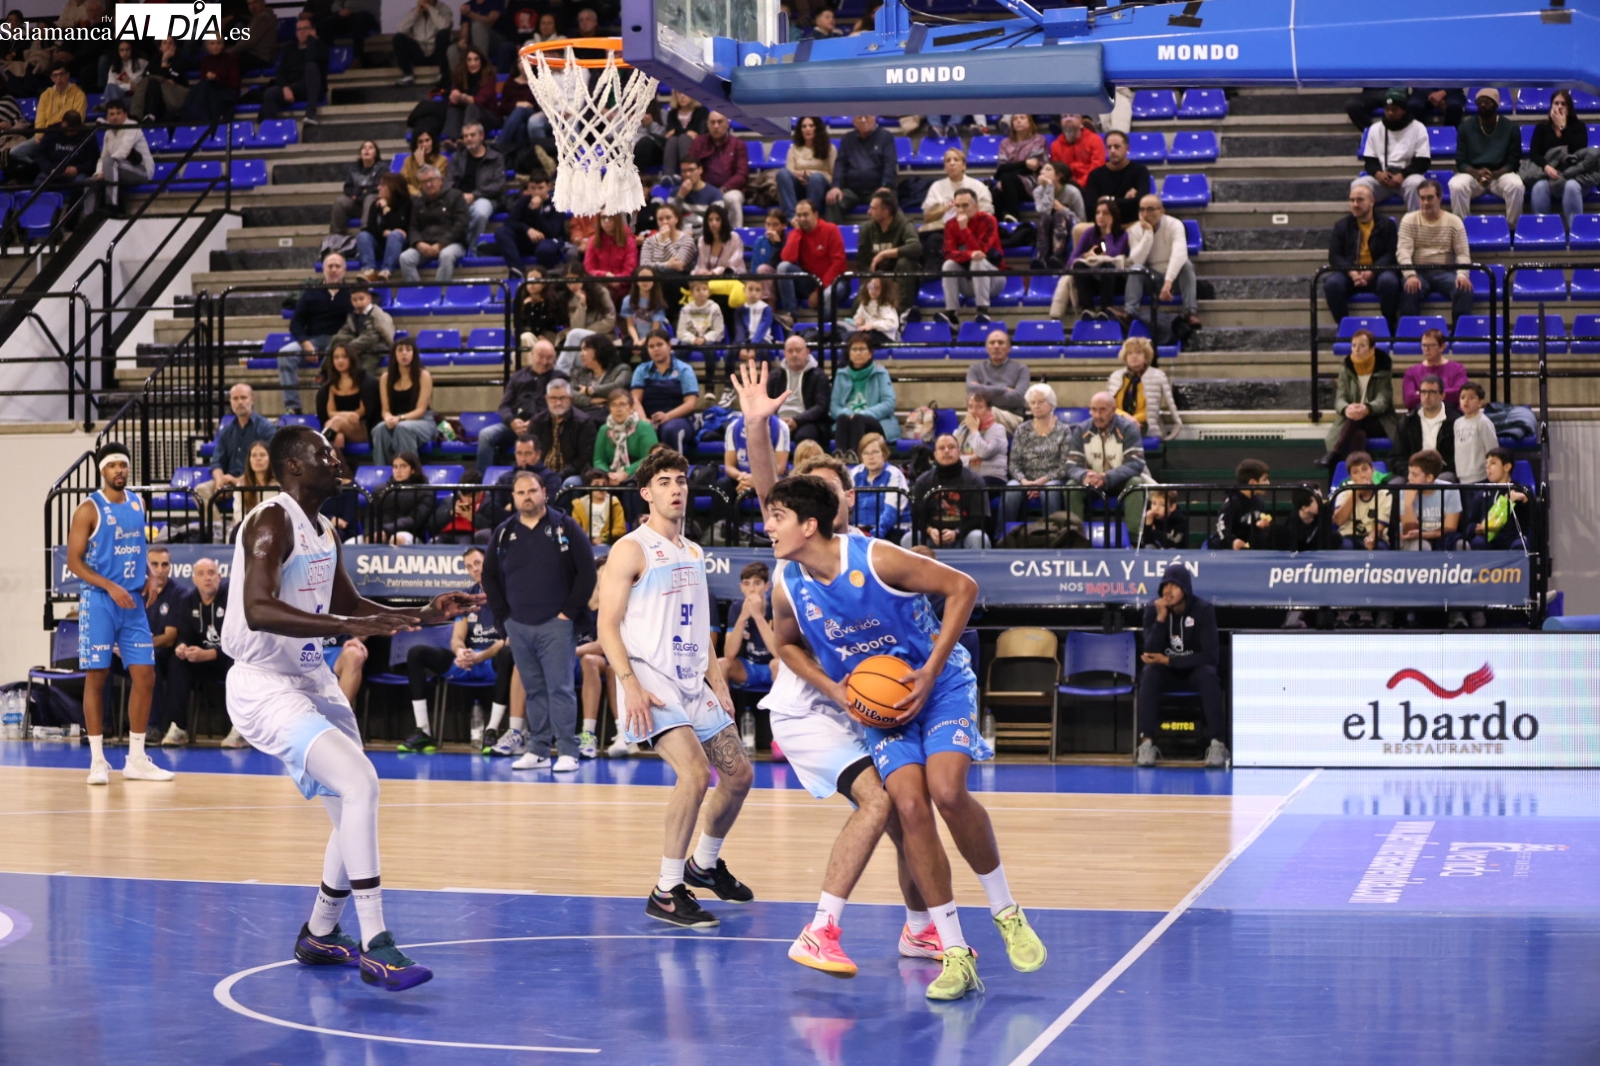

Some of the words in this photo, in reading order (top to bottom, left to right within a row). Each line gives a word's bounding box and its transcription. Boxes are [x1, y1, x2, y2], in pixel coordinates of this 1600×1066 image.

[1157, 44, 1239, 61] MONDO
[886, 66, 966, 84] MONDO
[1010, 560, 1110, 577] CASTILLA
[1121, 560, 1136, 581] Y
[1143, 555, 1199, 577] LEN
[1268, 563, 1522, 588] perfumeriasavenida.com
[387, 578, 421, 588] Patrimonio
[424, 578, 433, 588] de
[1059, 582, 1084, 592] NOS
[1085, 582, 1148, 597] IMPULSA
[835, 634, 898, 661] Xoborg
[853, 697, 899, 723] Wilson
[1342, 700, 1384, 741] el
[1399, 700, 1540, 742] bardo
[1382, 743, 1505, 755] RESTAURANTE
